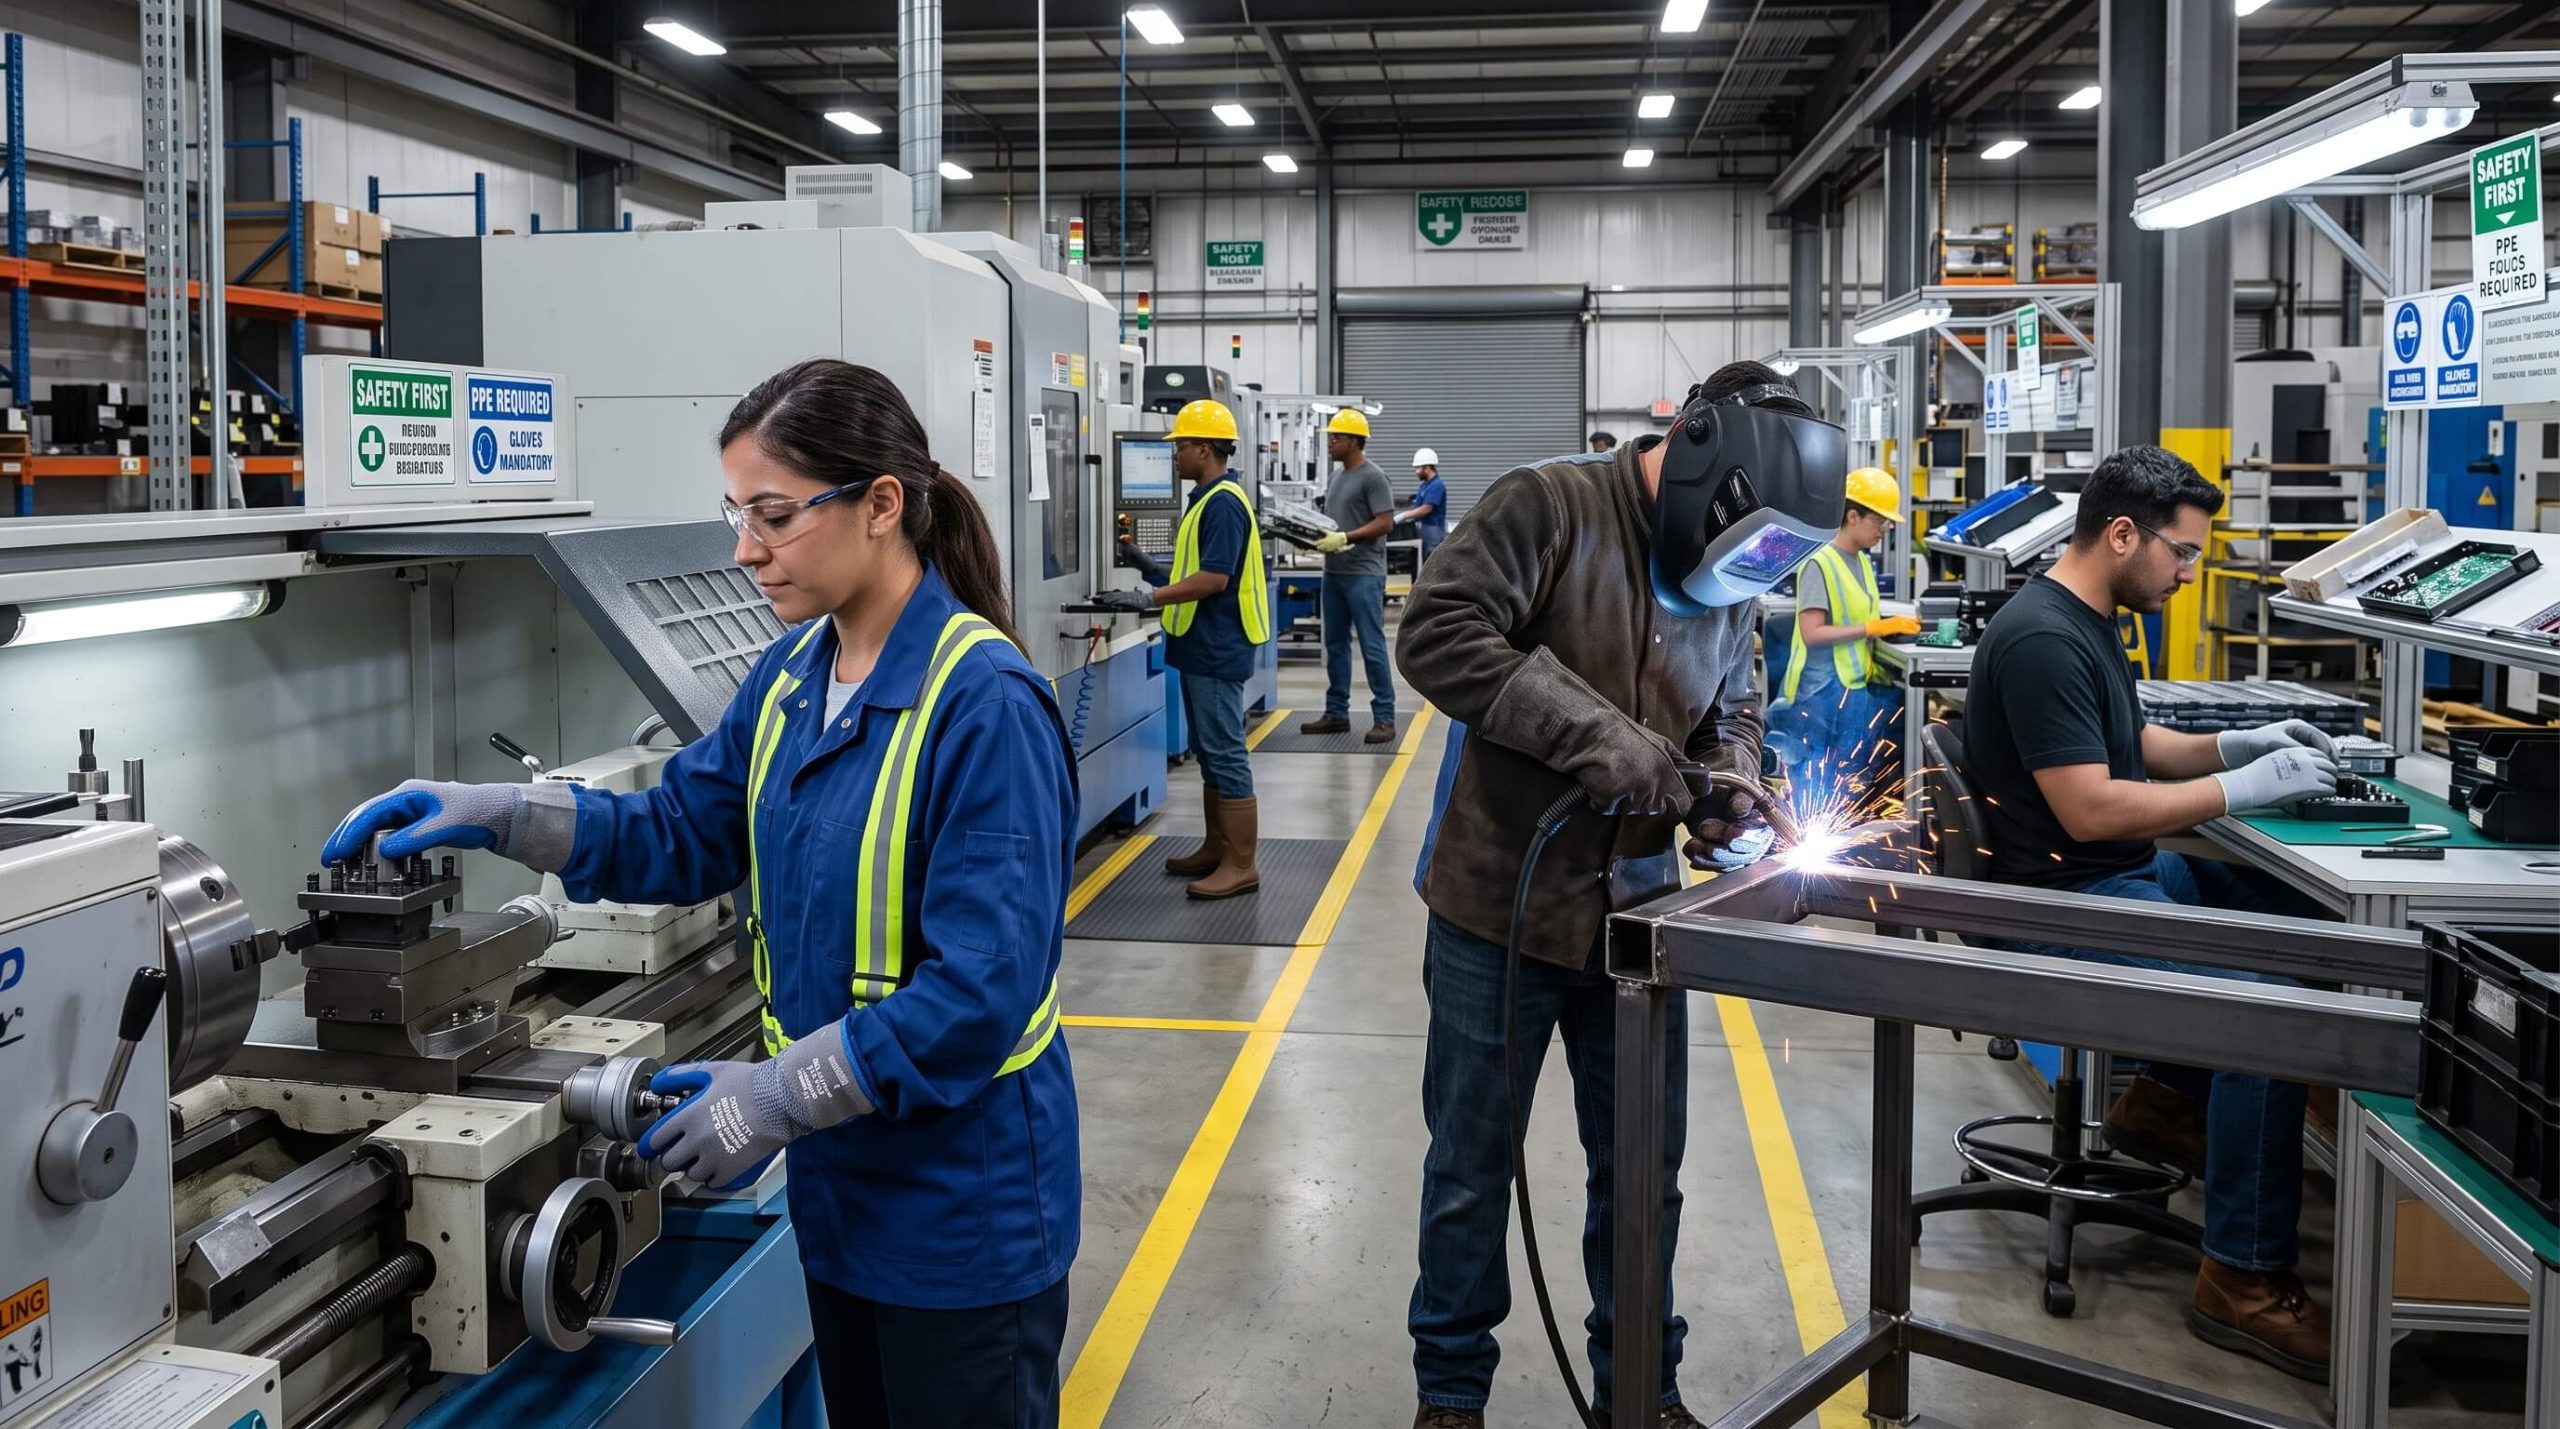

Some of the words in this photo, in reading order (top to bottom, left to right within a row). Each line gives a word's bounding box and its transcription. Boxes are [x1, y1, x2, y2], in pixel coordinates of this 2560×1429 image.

[2477, 145, 2532, 183] SAFETY
[1421, 196, 1464, 208] SAFETY
[2484, 176, 2525, 209] FIRST
[1212, 243, 1258, 254] SAFETY
[2496, 235, 2518, 255] PPE
[2480, 272, 2537, 297] REQUIRED
[356, 378, 407, 409] SAFETY
[412, 382, 448, 410] FIRST
[471, 386, 493, 412] PPE
[497, 388, 550, 416] REQUIRED
[509, 430, 543, 448] GLOVES
[500, 453, 553, 471] MANDATORY
